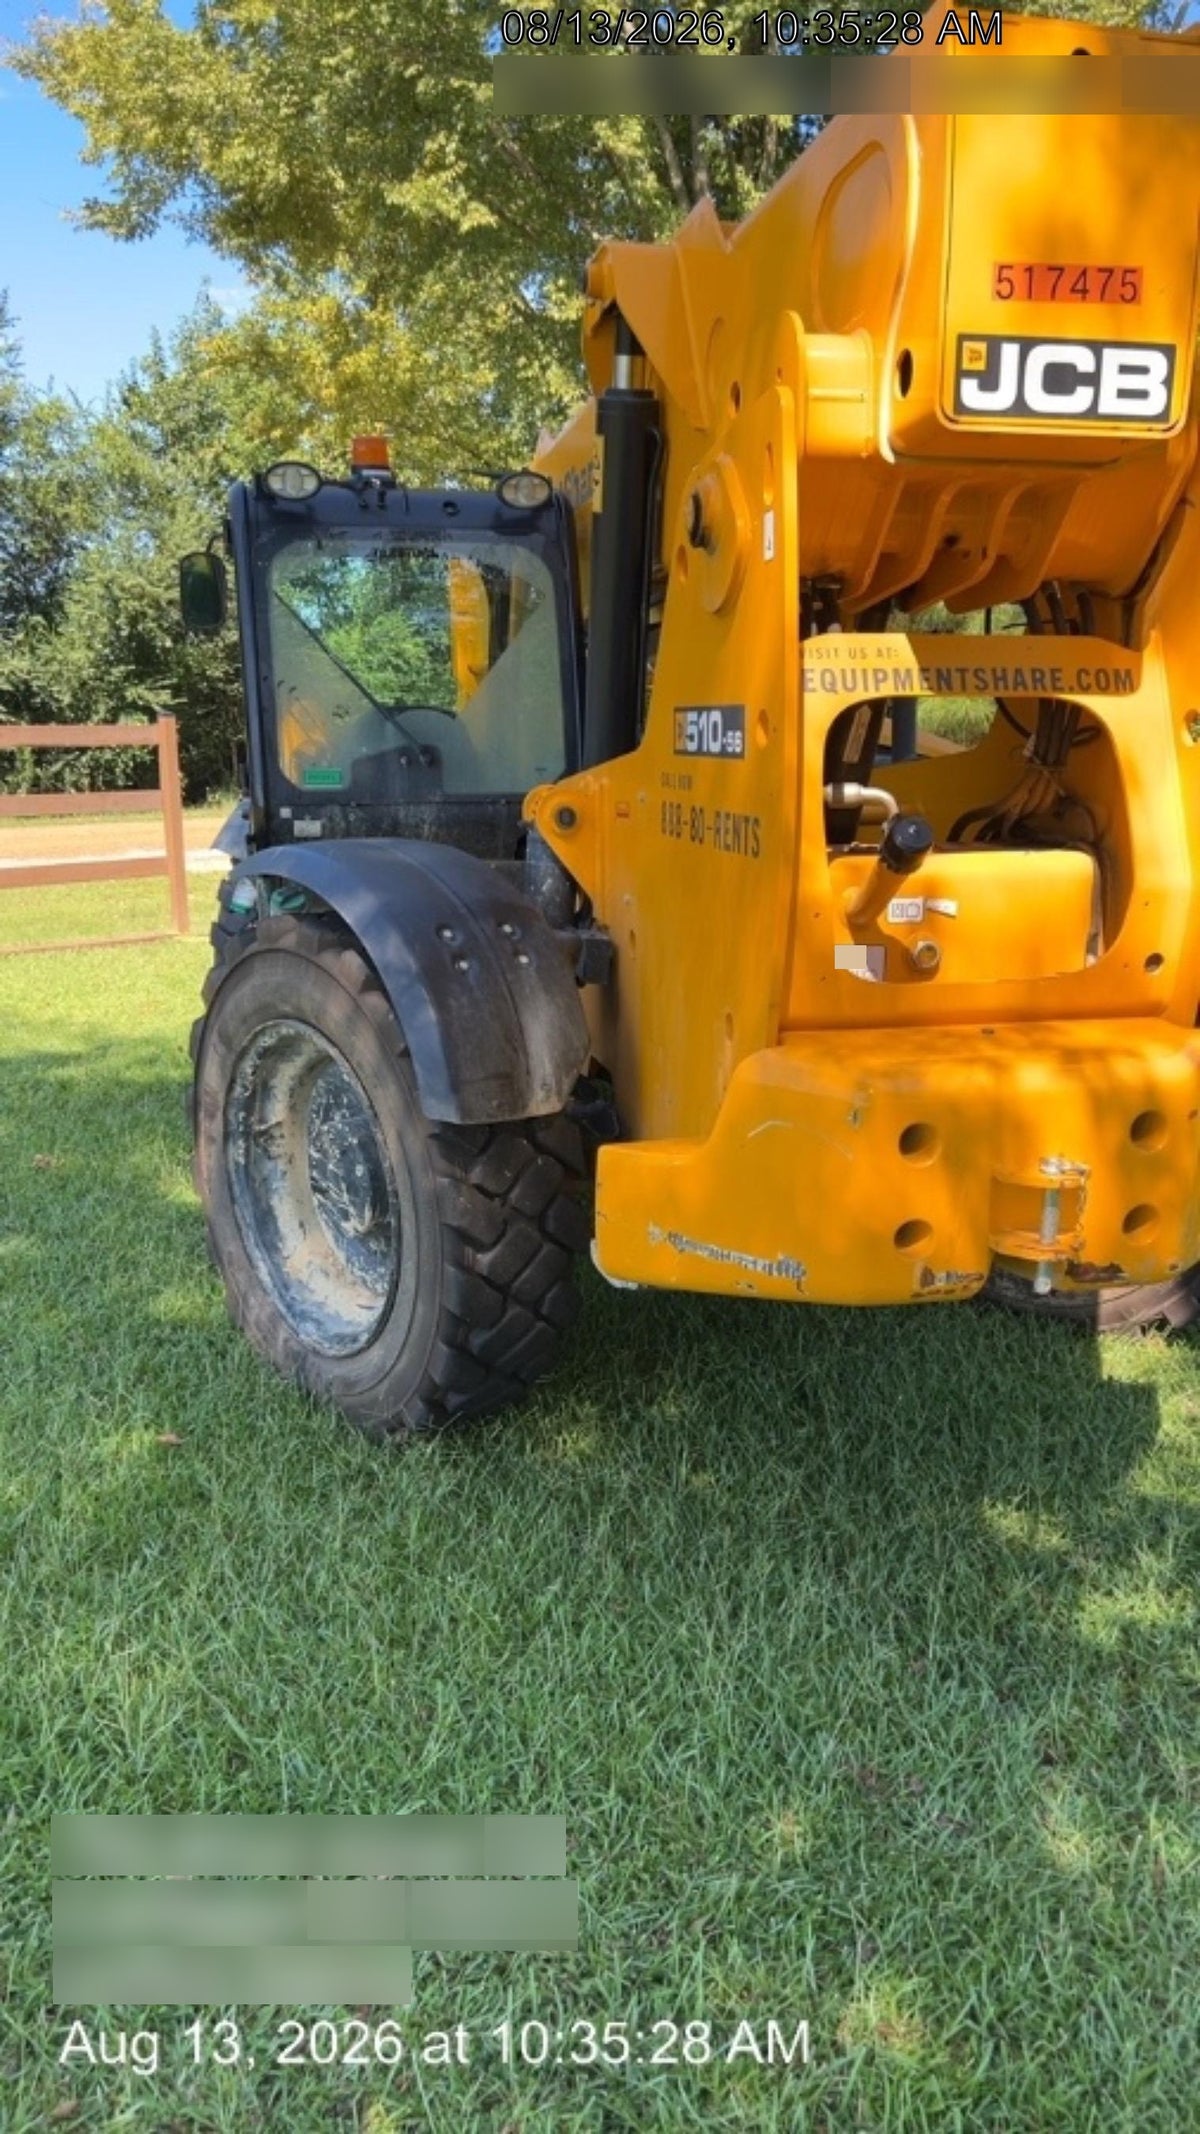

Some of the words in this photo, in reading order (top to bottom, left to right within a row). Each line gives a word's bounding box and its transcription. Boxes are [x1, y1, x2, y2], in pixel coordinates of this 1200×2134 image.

[995, 264, 1139, 304] 517475
[960, 343, 1169, 416] JCB
[848, 647, 867, 660] US
[802, 667, 1135, 694] EQUIPMENTSHARE.COM
